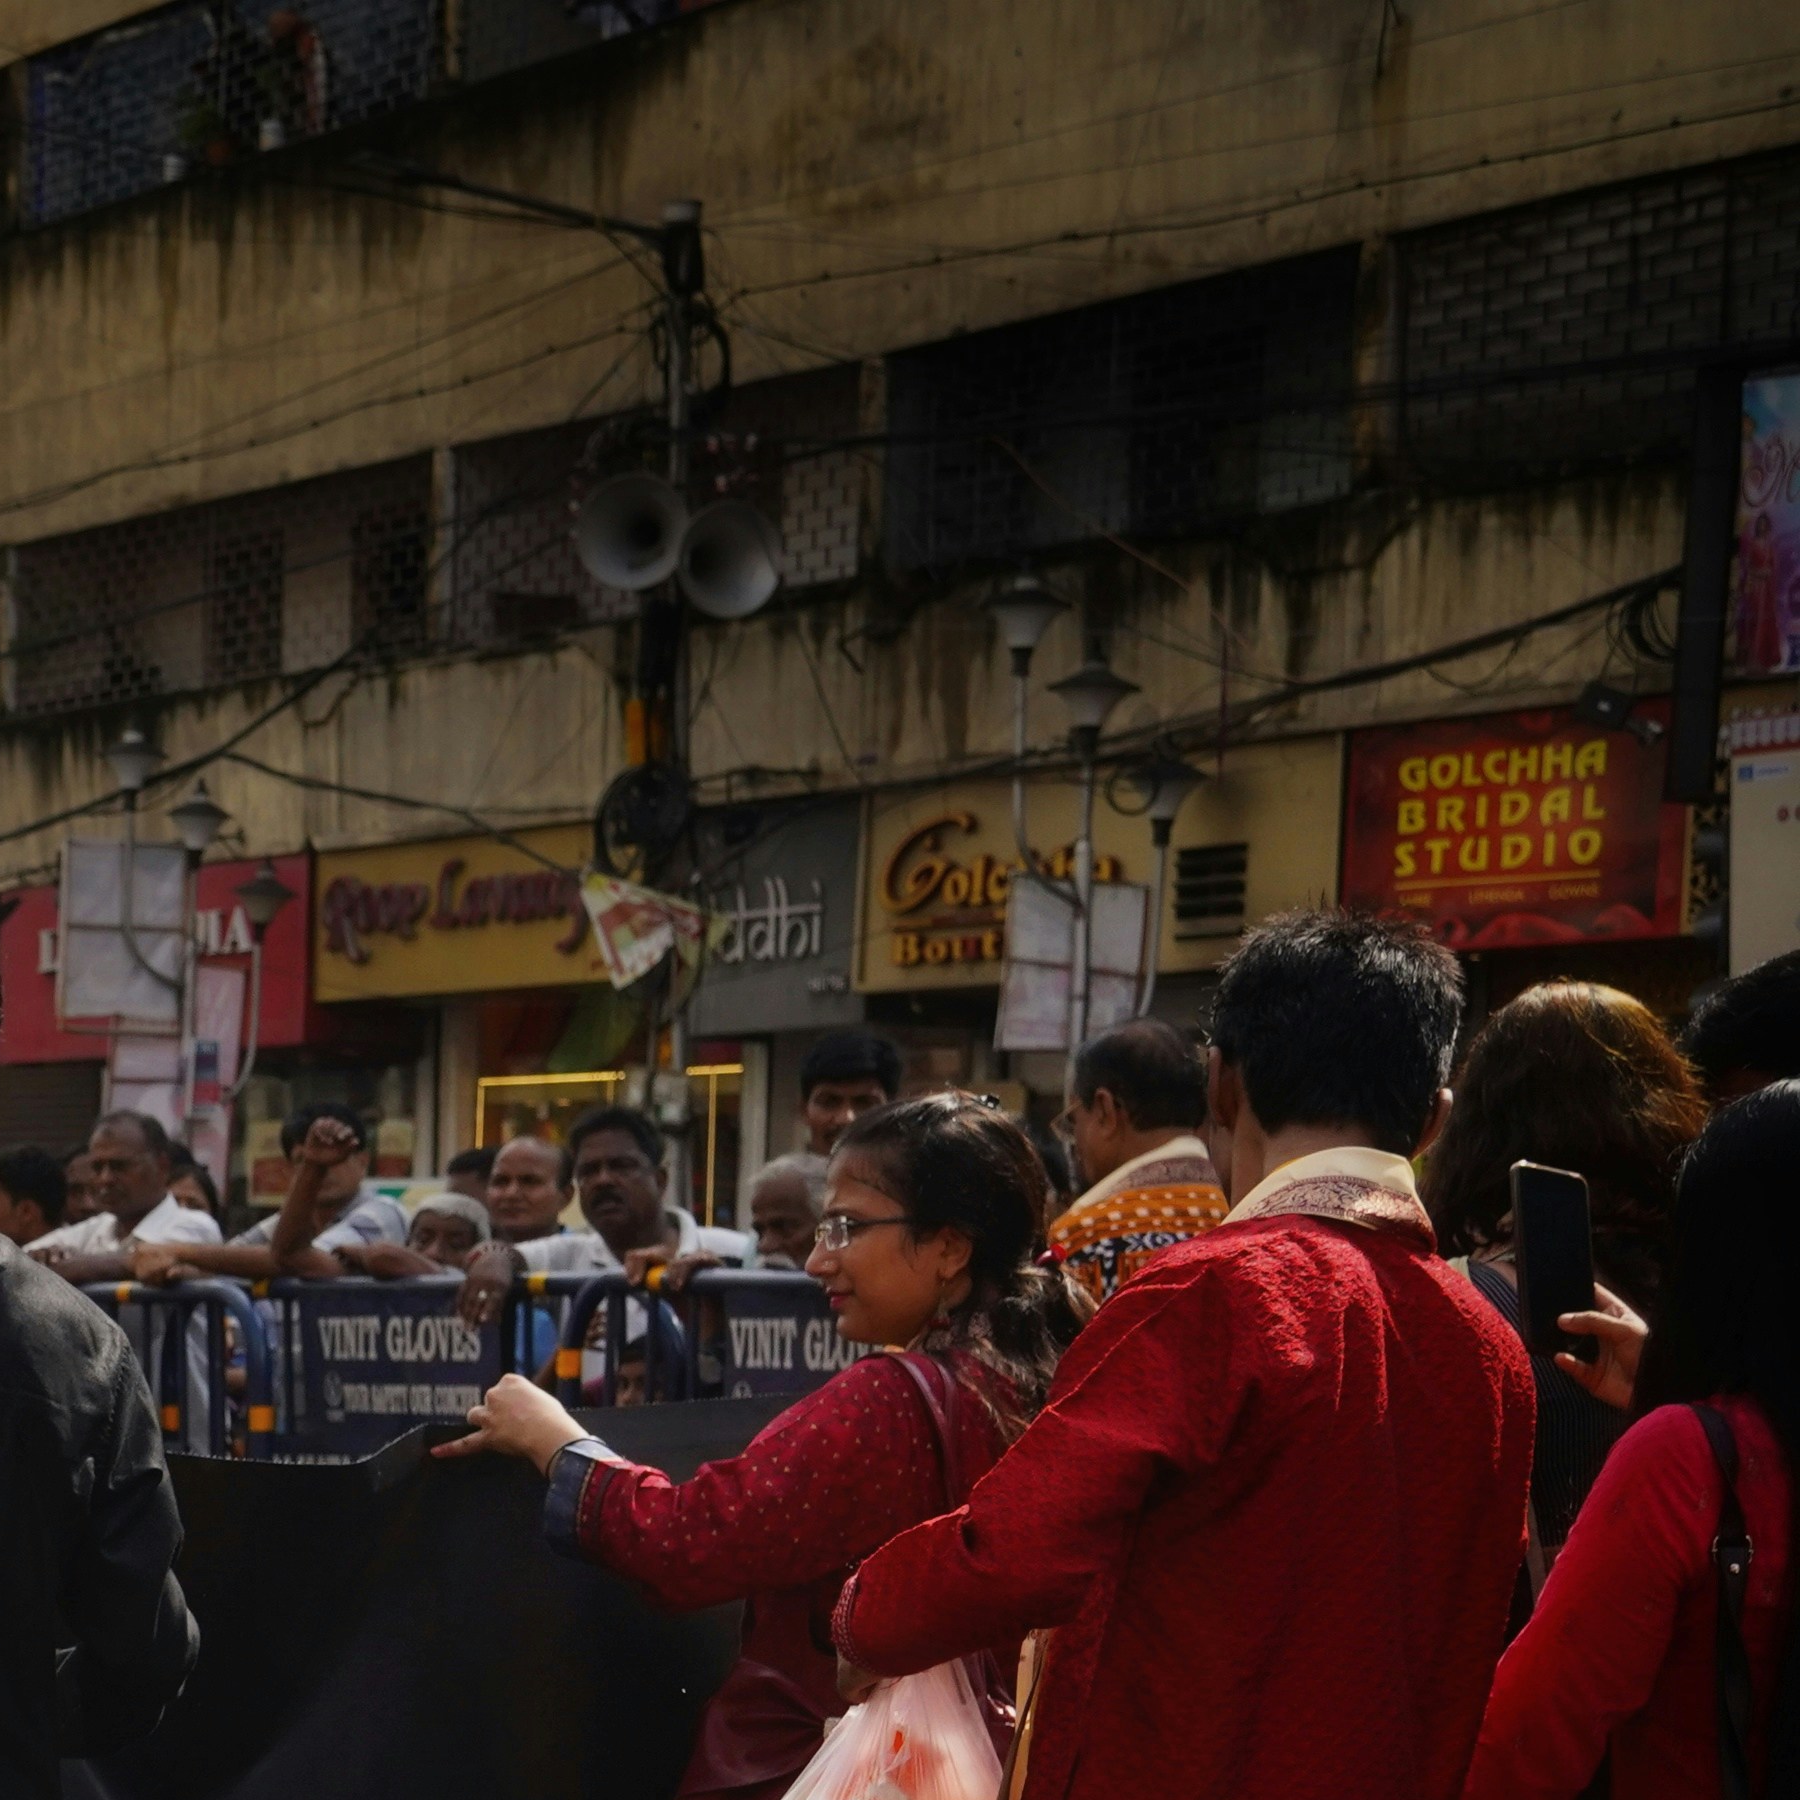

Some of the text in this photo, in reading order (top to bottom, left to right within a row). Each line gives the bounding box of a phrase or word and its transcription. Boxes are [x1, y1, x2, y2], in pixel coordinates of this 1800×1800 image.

[1398, 737, 1609, 793] GOLCHHA
[1396, 783, 1608, 837] BRIDAL
[1393, 826, 1604, 878] STUDIO
[318, 1315, 382, 1361] VINIT
[385, 1313, 482, 1364] GLOVES
[728, 1316, 883, 1372] VINIT GLO
